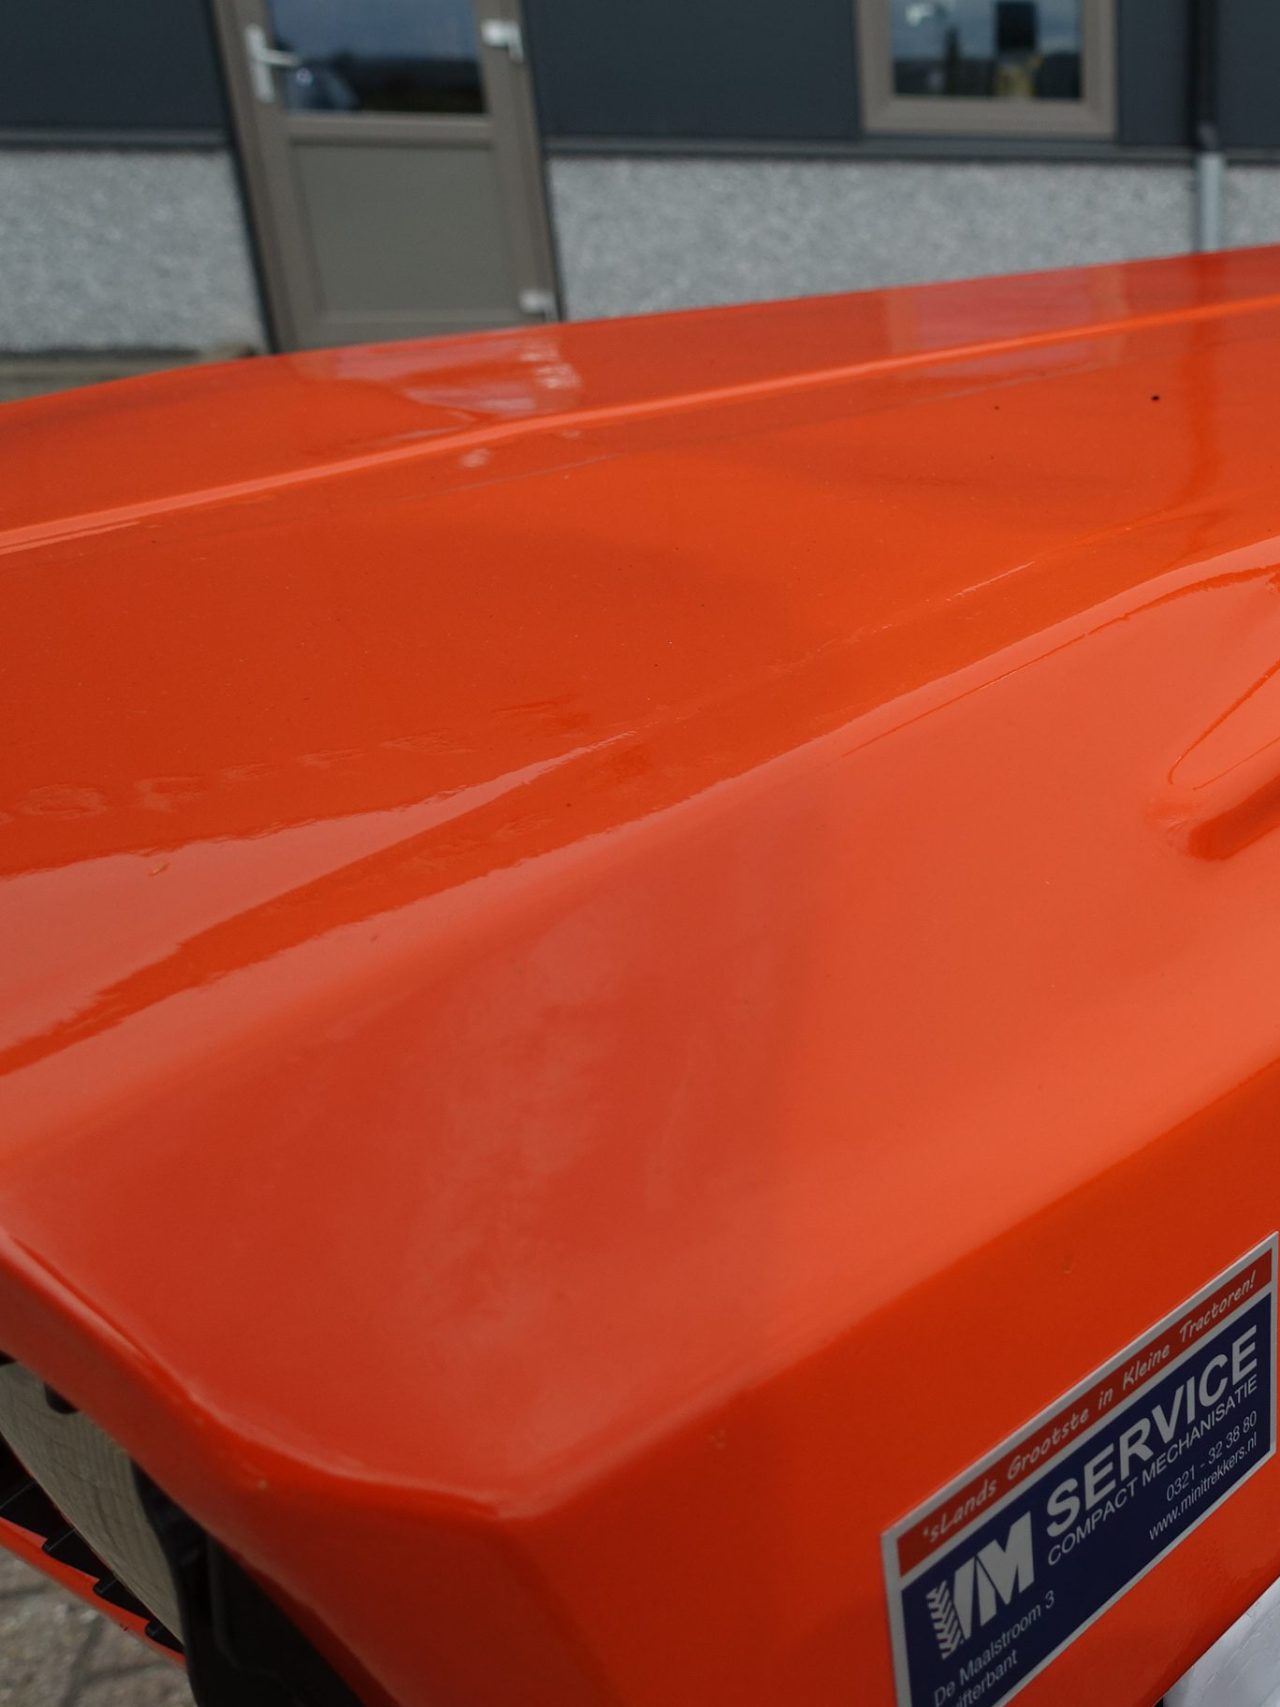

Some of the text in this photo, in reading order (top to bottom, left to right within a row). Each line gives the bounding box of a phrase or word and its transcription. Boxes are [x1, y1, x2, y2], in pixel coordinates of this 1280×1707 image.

[1006, 1408, 1090, 1481] Grootste
[1097, 1387, 1114, 1411] in
[1122, 1343, 1171, 1391] Kleine
[1178, 1270, 1257, 1343] Tractoren!
[1046, 1324, 1258, 1538] SERVICE
[1047, 1374, 1258, 1566] COMPACT MECHANISATIE
[1148, 1431, 1258, 1541] www.minitrekkers.nl
[1166, 1464, 1196, 1502] 0321
[1208, 1440, 1224, 1466] 32
[1225, 1424, 1241, 1449] 38
[1242, 1410, 1258, 1434] 80
[933, 1589, 1055, 1707] De Maalstroom 3
